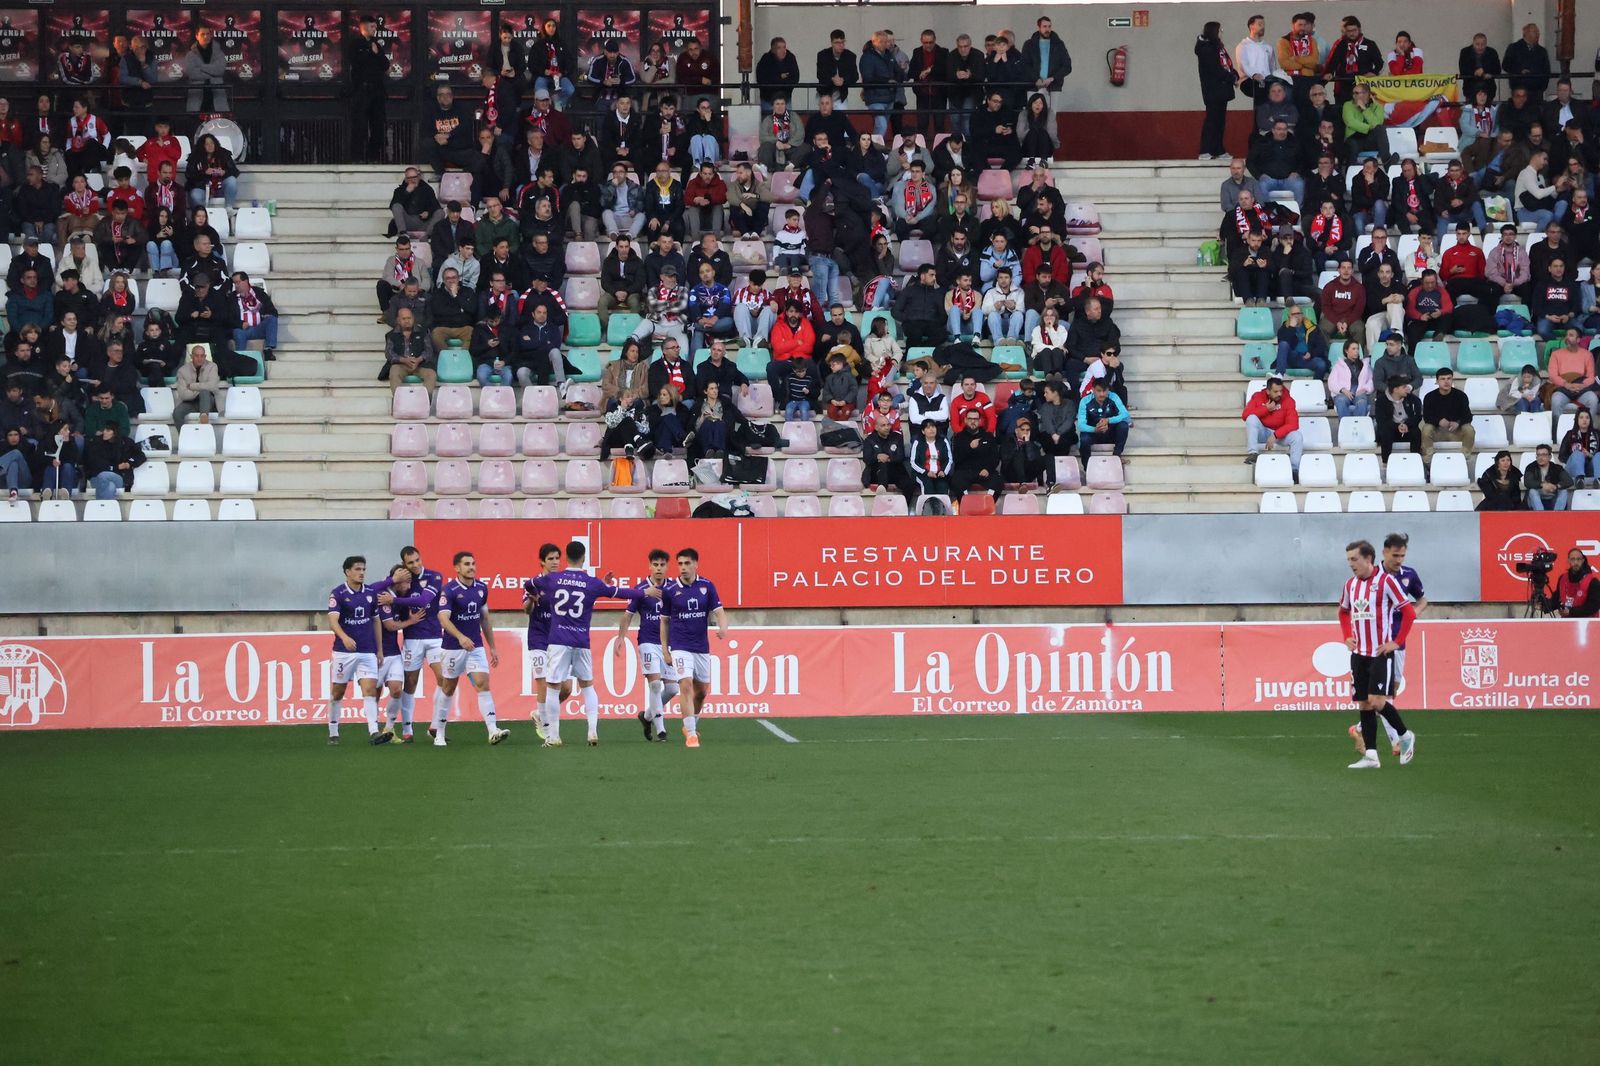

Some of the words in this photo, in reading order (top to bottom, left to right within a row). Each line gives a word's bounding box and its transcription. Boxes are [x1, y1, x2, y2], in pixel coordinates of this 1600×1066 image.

[822, 545, 1045, 563] RESTAURANTE
[1497, 553, 1534, 561] NISS
[773, 570, 903, 587] PALACIO
[919, 569, 976, 586] DEL
[991, 567, 1094, 585] DUERO
[554, 588, 586, 619] 23
[449, 657, 455, 668] 5
[532, 656, 544, 666] 20
[643, 652, 651, 662] 10
[675, 657, 684, 668] 19
[140, 641, 204, 703] La
[337, 662, 344, 673] 3
[891, 632, 954, 694] La
[975, 632, 1174, 714] Opinión
[1504, 672, 1559, 687] Junta
[1565, 671, 1590, 687] de
[1255, 677, 1353, 703] juventu
[912, 697, 932, 713] El
[938, 697, 1011, 712] Correo
[1031, 695, 1056, 711] de
[1061, 695, 1143, 711] Zamora
[1273, 700, 1320, 711] castilla
[1449, 692, 1519, 707] Castilla
[1525, 695, 1536, 709] y
[1543, 691, 1590, 707] León
[160, 706, 182, 722] El
[187, 705, 261, 722] Correo
[282, 703, 307, 720] de
